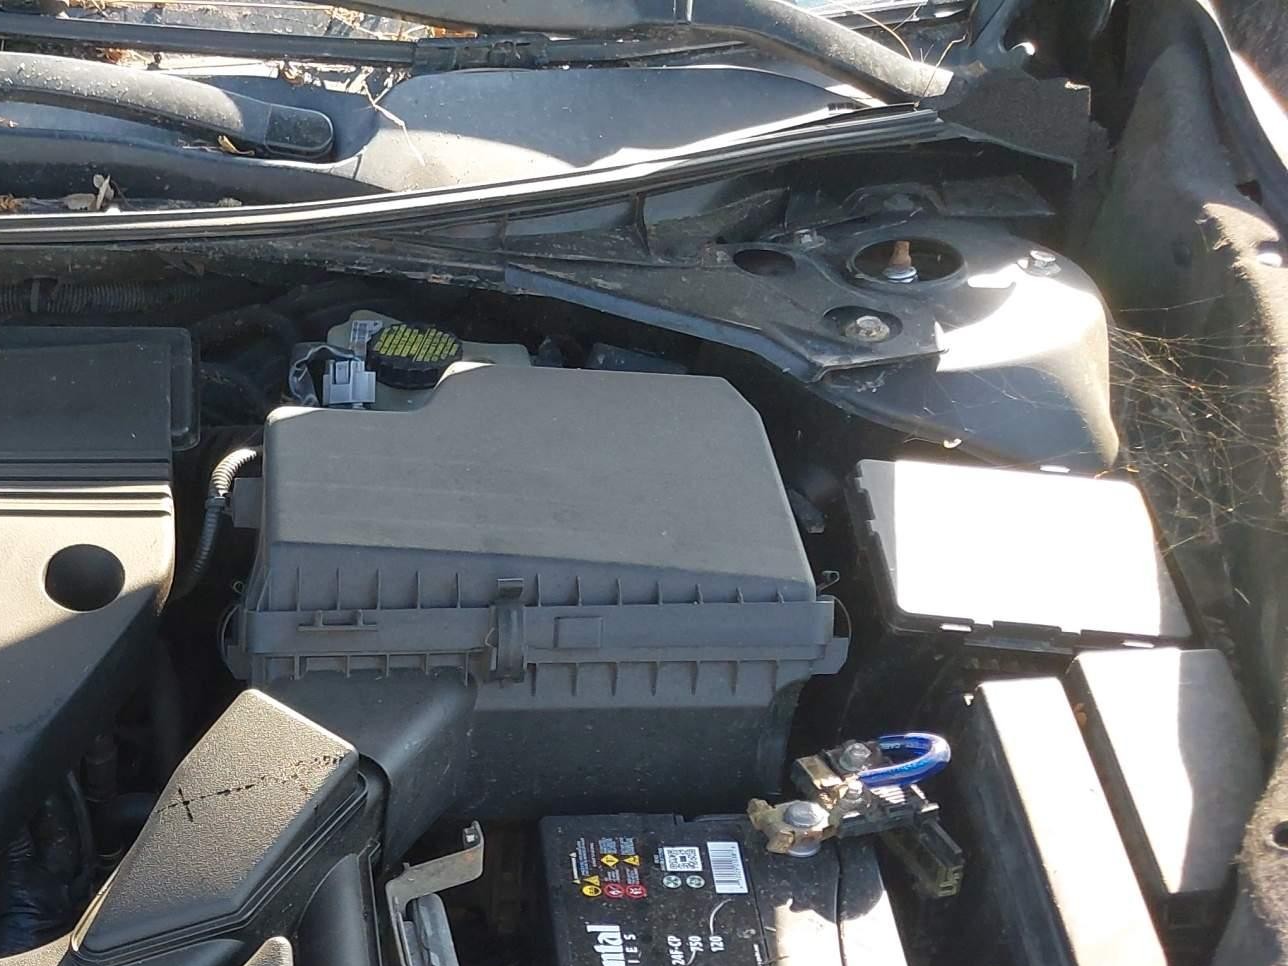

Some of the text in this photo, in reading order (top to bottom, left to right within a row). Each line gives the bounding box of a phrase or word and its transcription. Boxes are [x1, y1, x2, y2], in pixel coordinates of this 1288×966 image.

[667, 935, 685, 965] 24F-CP
[687, 935, 703, 951] 750
[708, 935, 724, 951] 120
